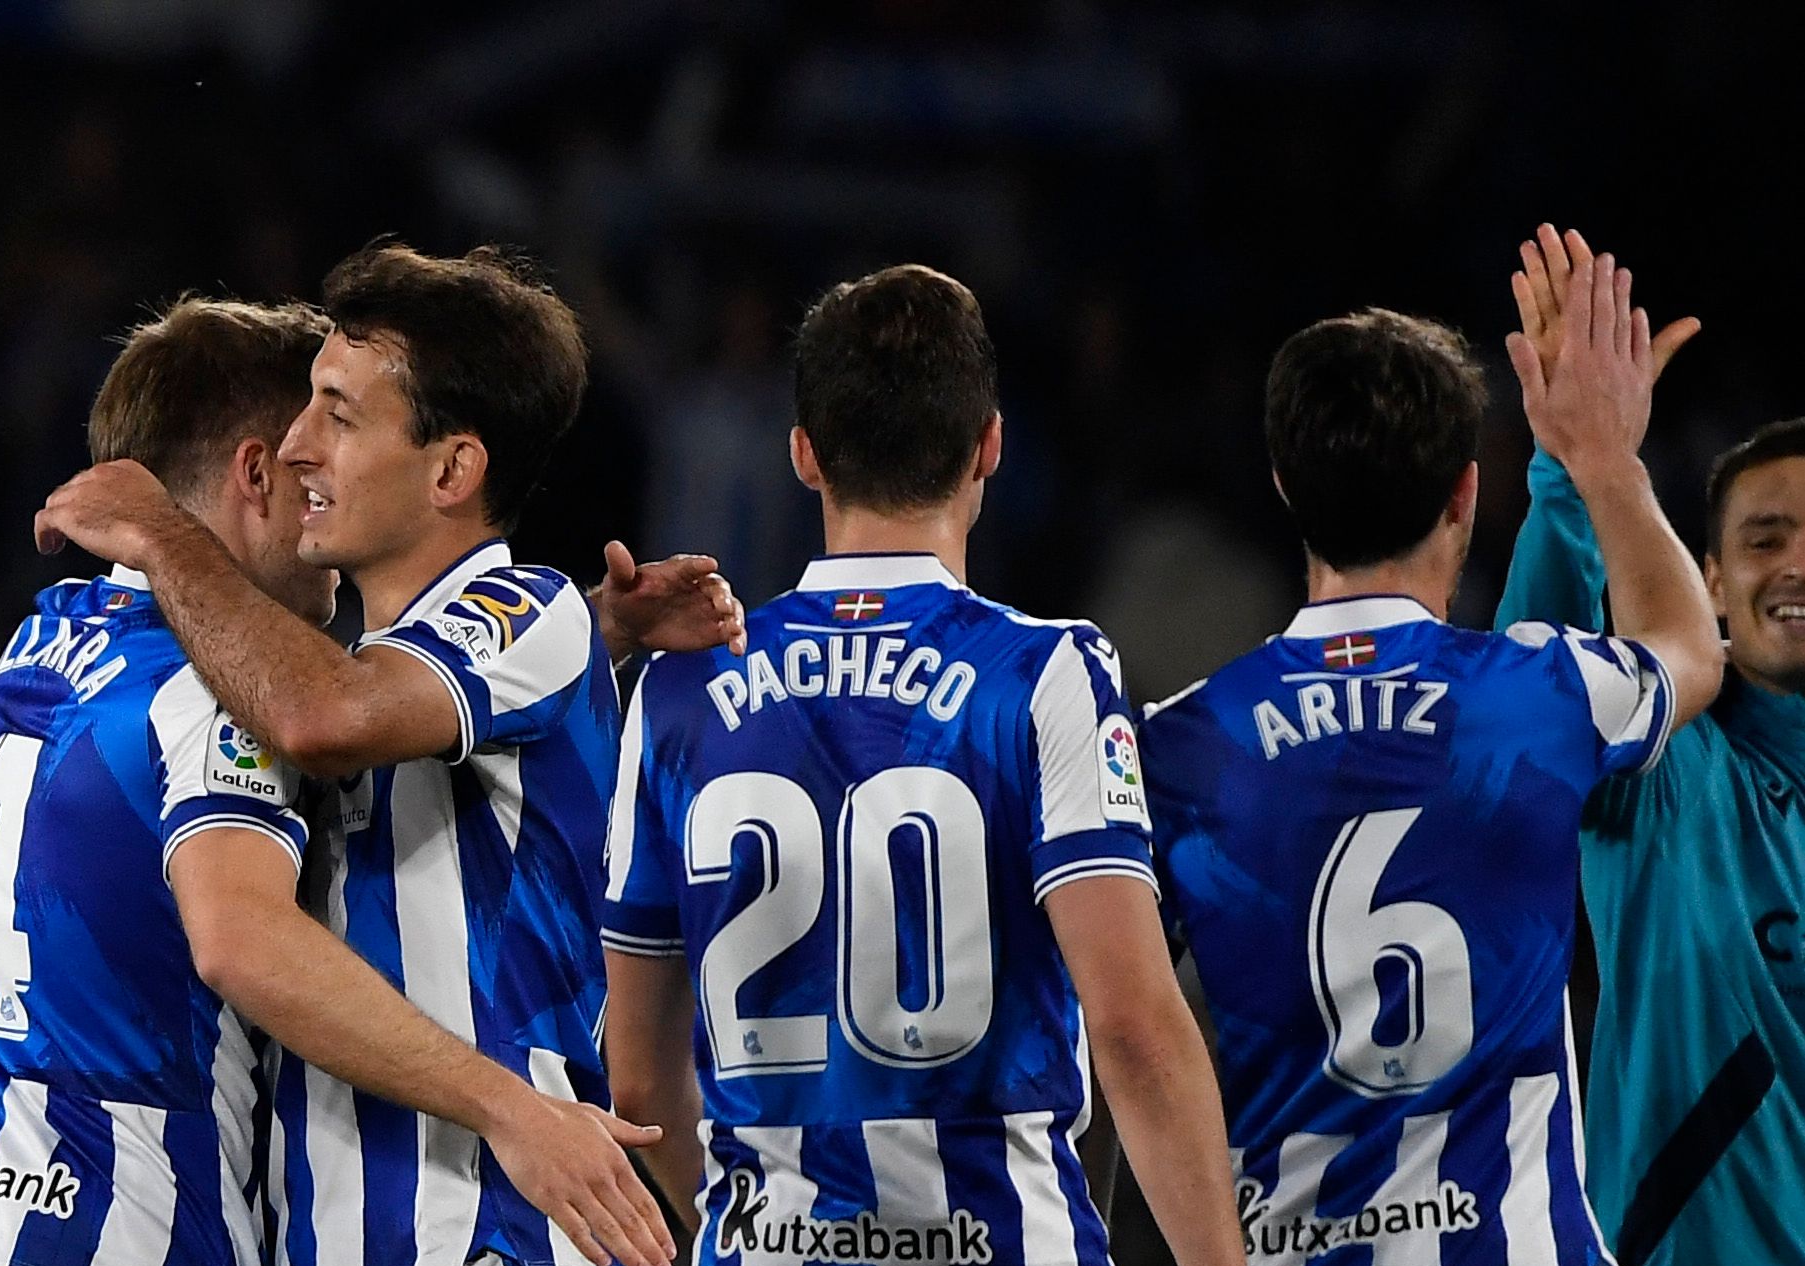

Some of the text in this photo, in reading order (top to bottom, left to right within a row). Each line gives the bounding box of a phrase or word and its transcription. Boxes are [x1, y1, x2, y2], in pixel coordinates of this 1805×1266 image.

[706, 635, 977, 732] PACHECO
[1252, 677, 1450, 761] ARITZ
[213, 770, 277, 796] LaLiga
[685, 766, 994, 1081] 20
[1308, 806, 1473, 1099] 6
[720, 1174, 988, 1260] Kutxabank
